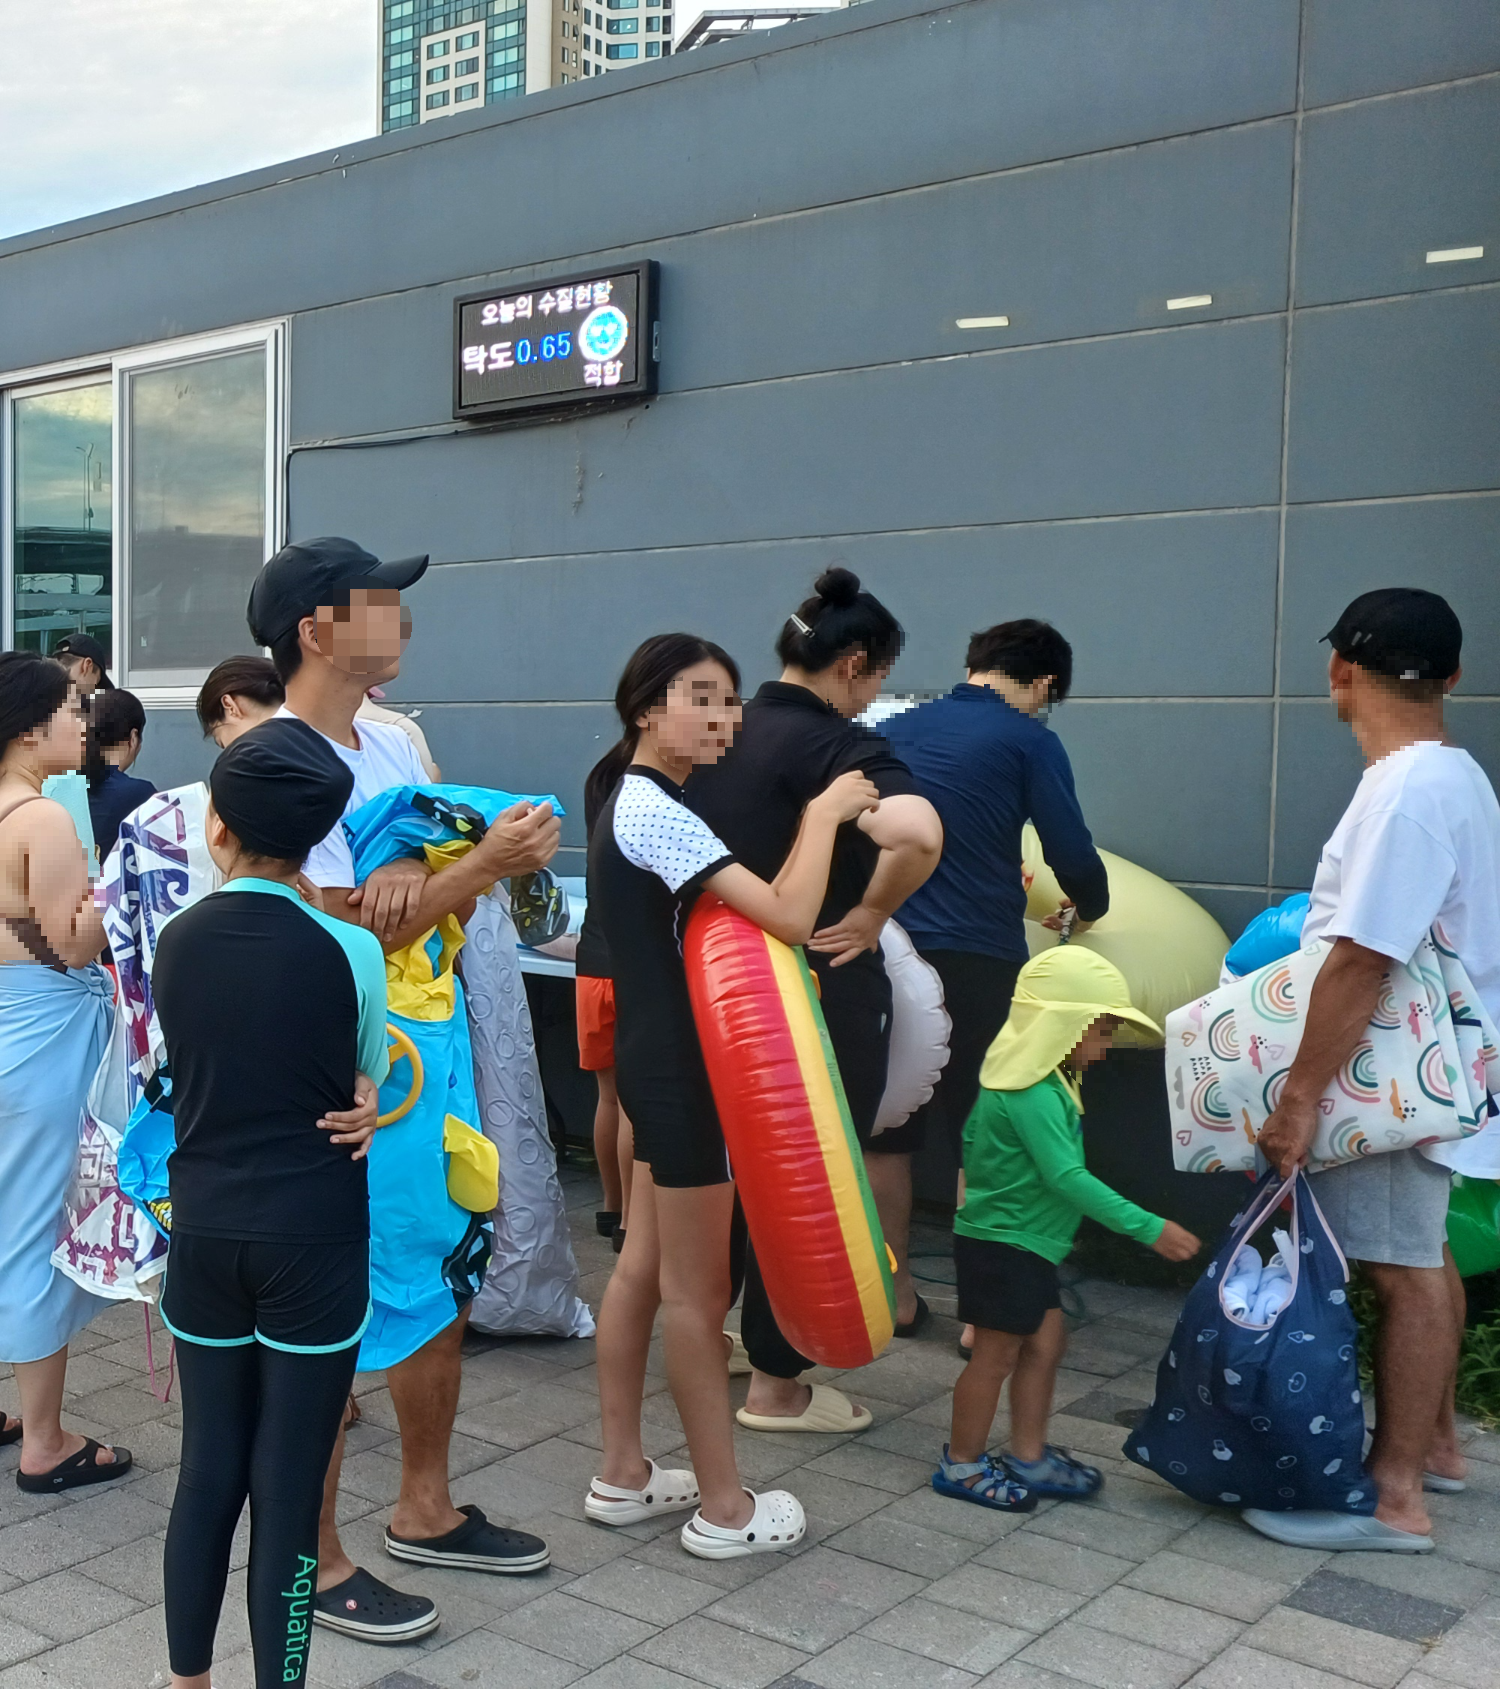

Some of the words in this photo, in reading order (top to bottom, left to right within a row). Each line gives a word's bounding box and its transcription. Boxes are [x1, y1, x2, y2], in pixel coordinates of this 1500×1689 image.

[481, 295, 533, 326] 오늘의
[538, 280, 614, 316] 수질현황
[462, 341, 515, 375] 탁도
[515, 331, 572, 365] 0.65
[583, 360, 623, 387] 적합
[281, 1553, 317, 1683] Aquatica
